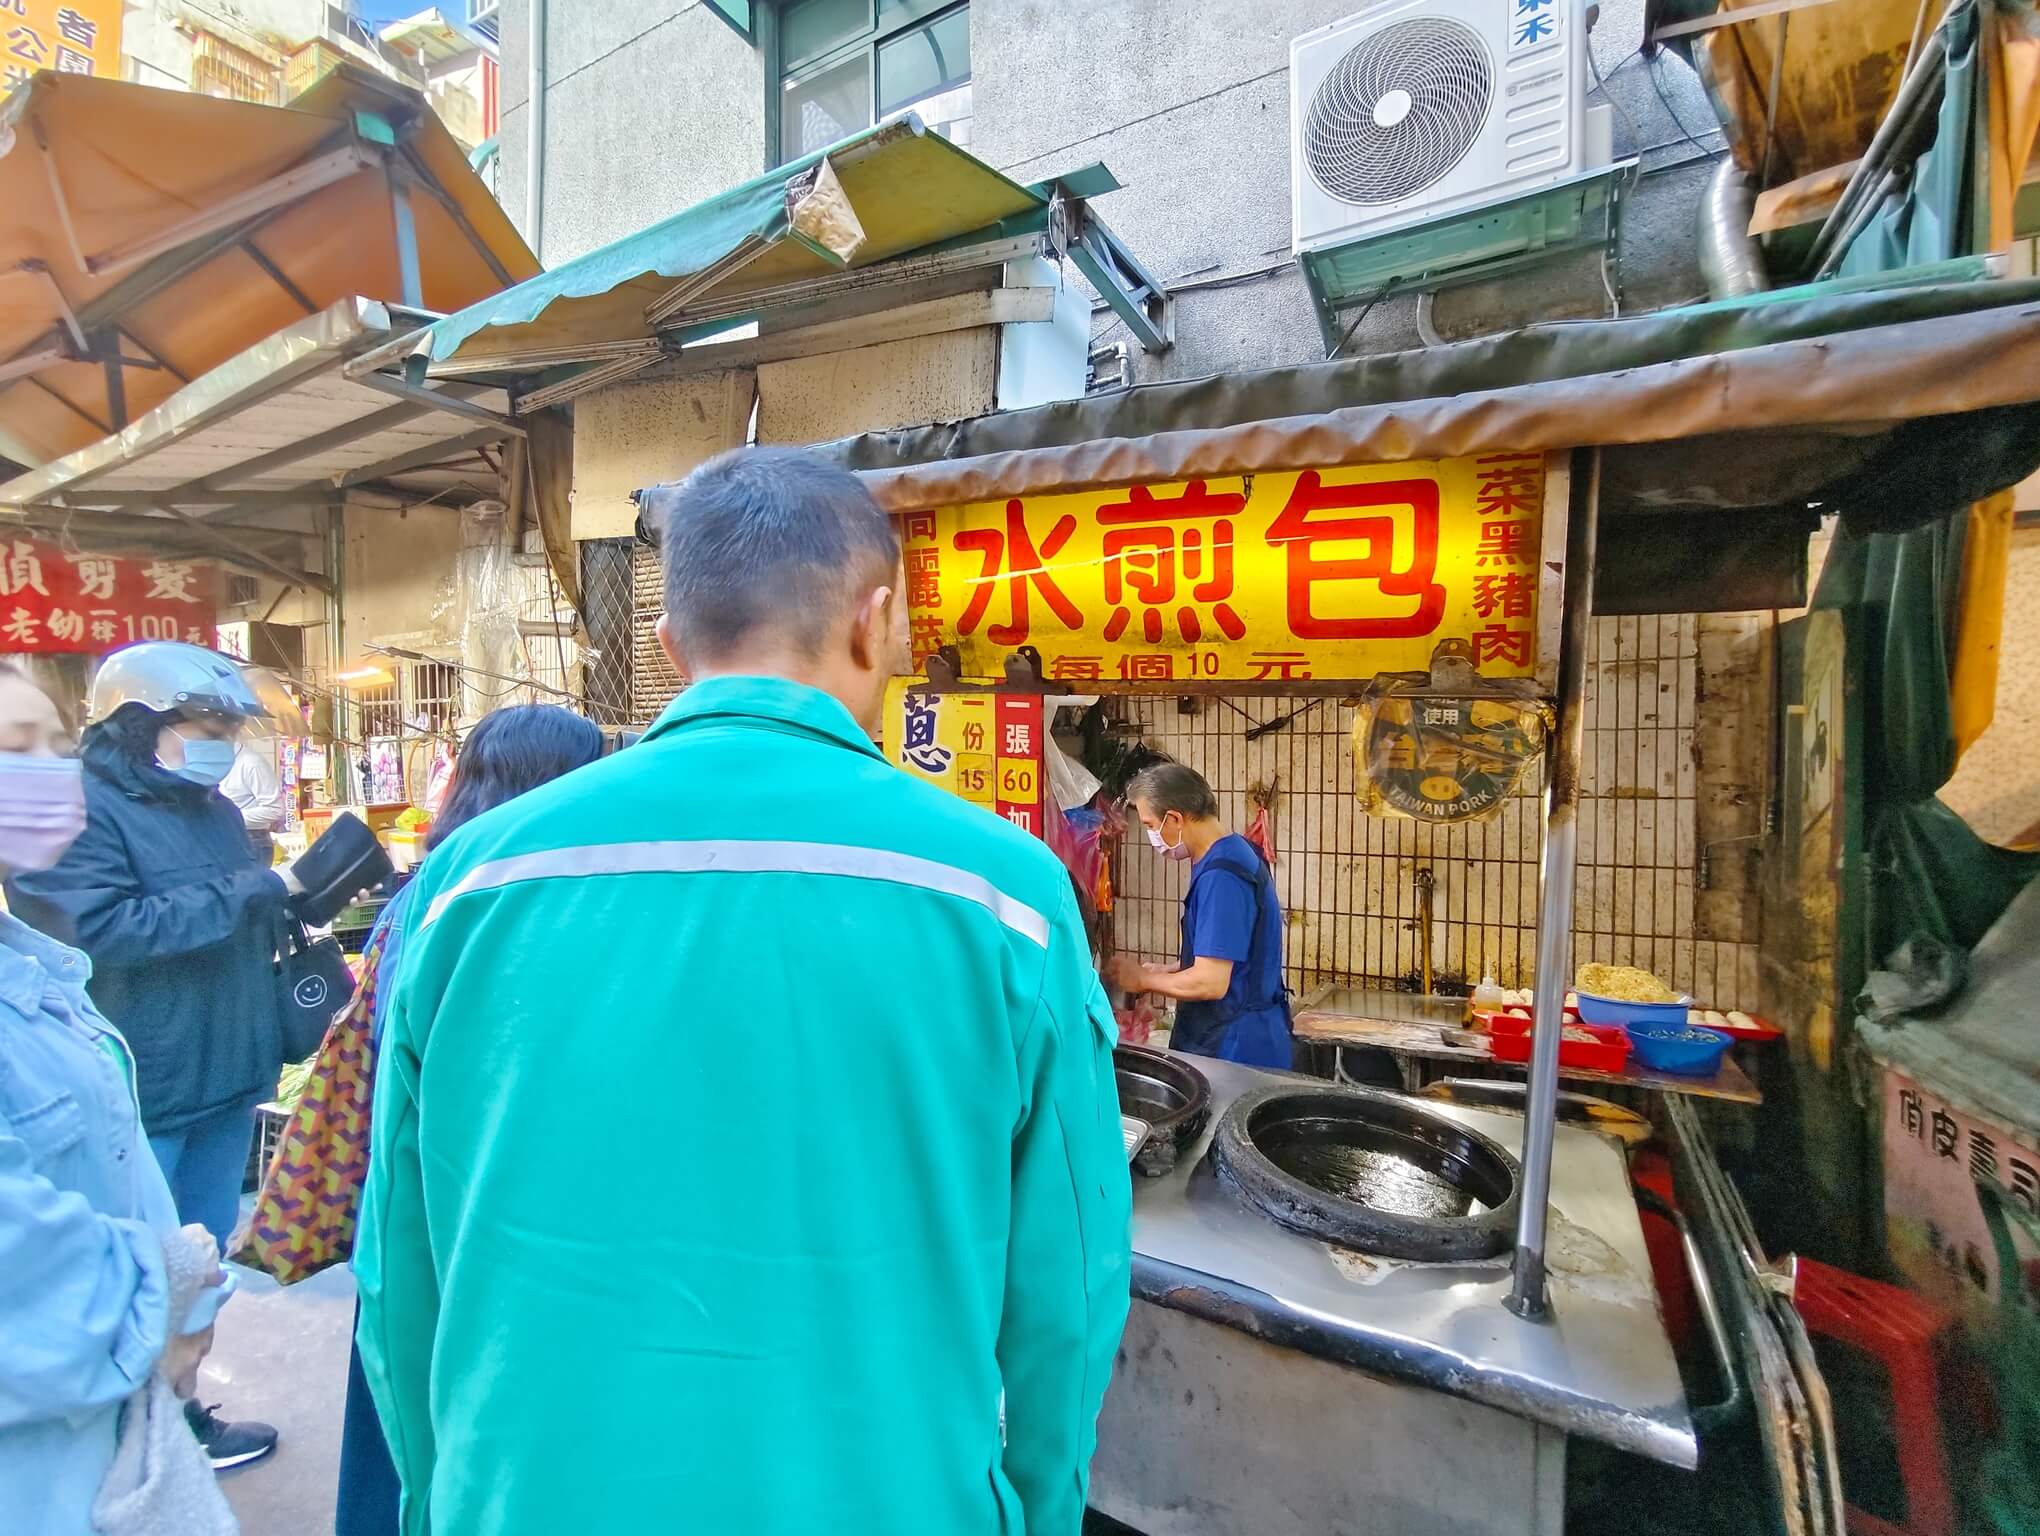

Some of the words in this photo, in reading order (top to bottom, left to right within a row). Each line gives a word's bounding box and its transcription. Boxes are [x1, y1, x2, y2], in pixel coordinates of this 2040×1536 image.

[953, 470, 1447, 646] 水煎包
[1471, 454, 1541, 668] 菜黑豬肉
[1423, 708, 1459, 726] 使用
[960, 768, 985, 791] 15
[1003, 768, 1032, 793] 60
[1389, 784, 1445, 816] TAIWAN
[1448, 789, 1493, 816] PORK
